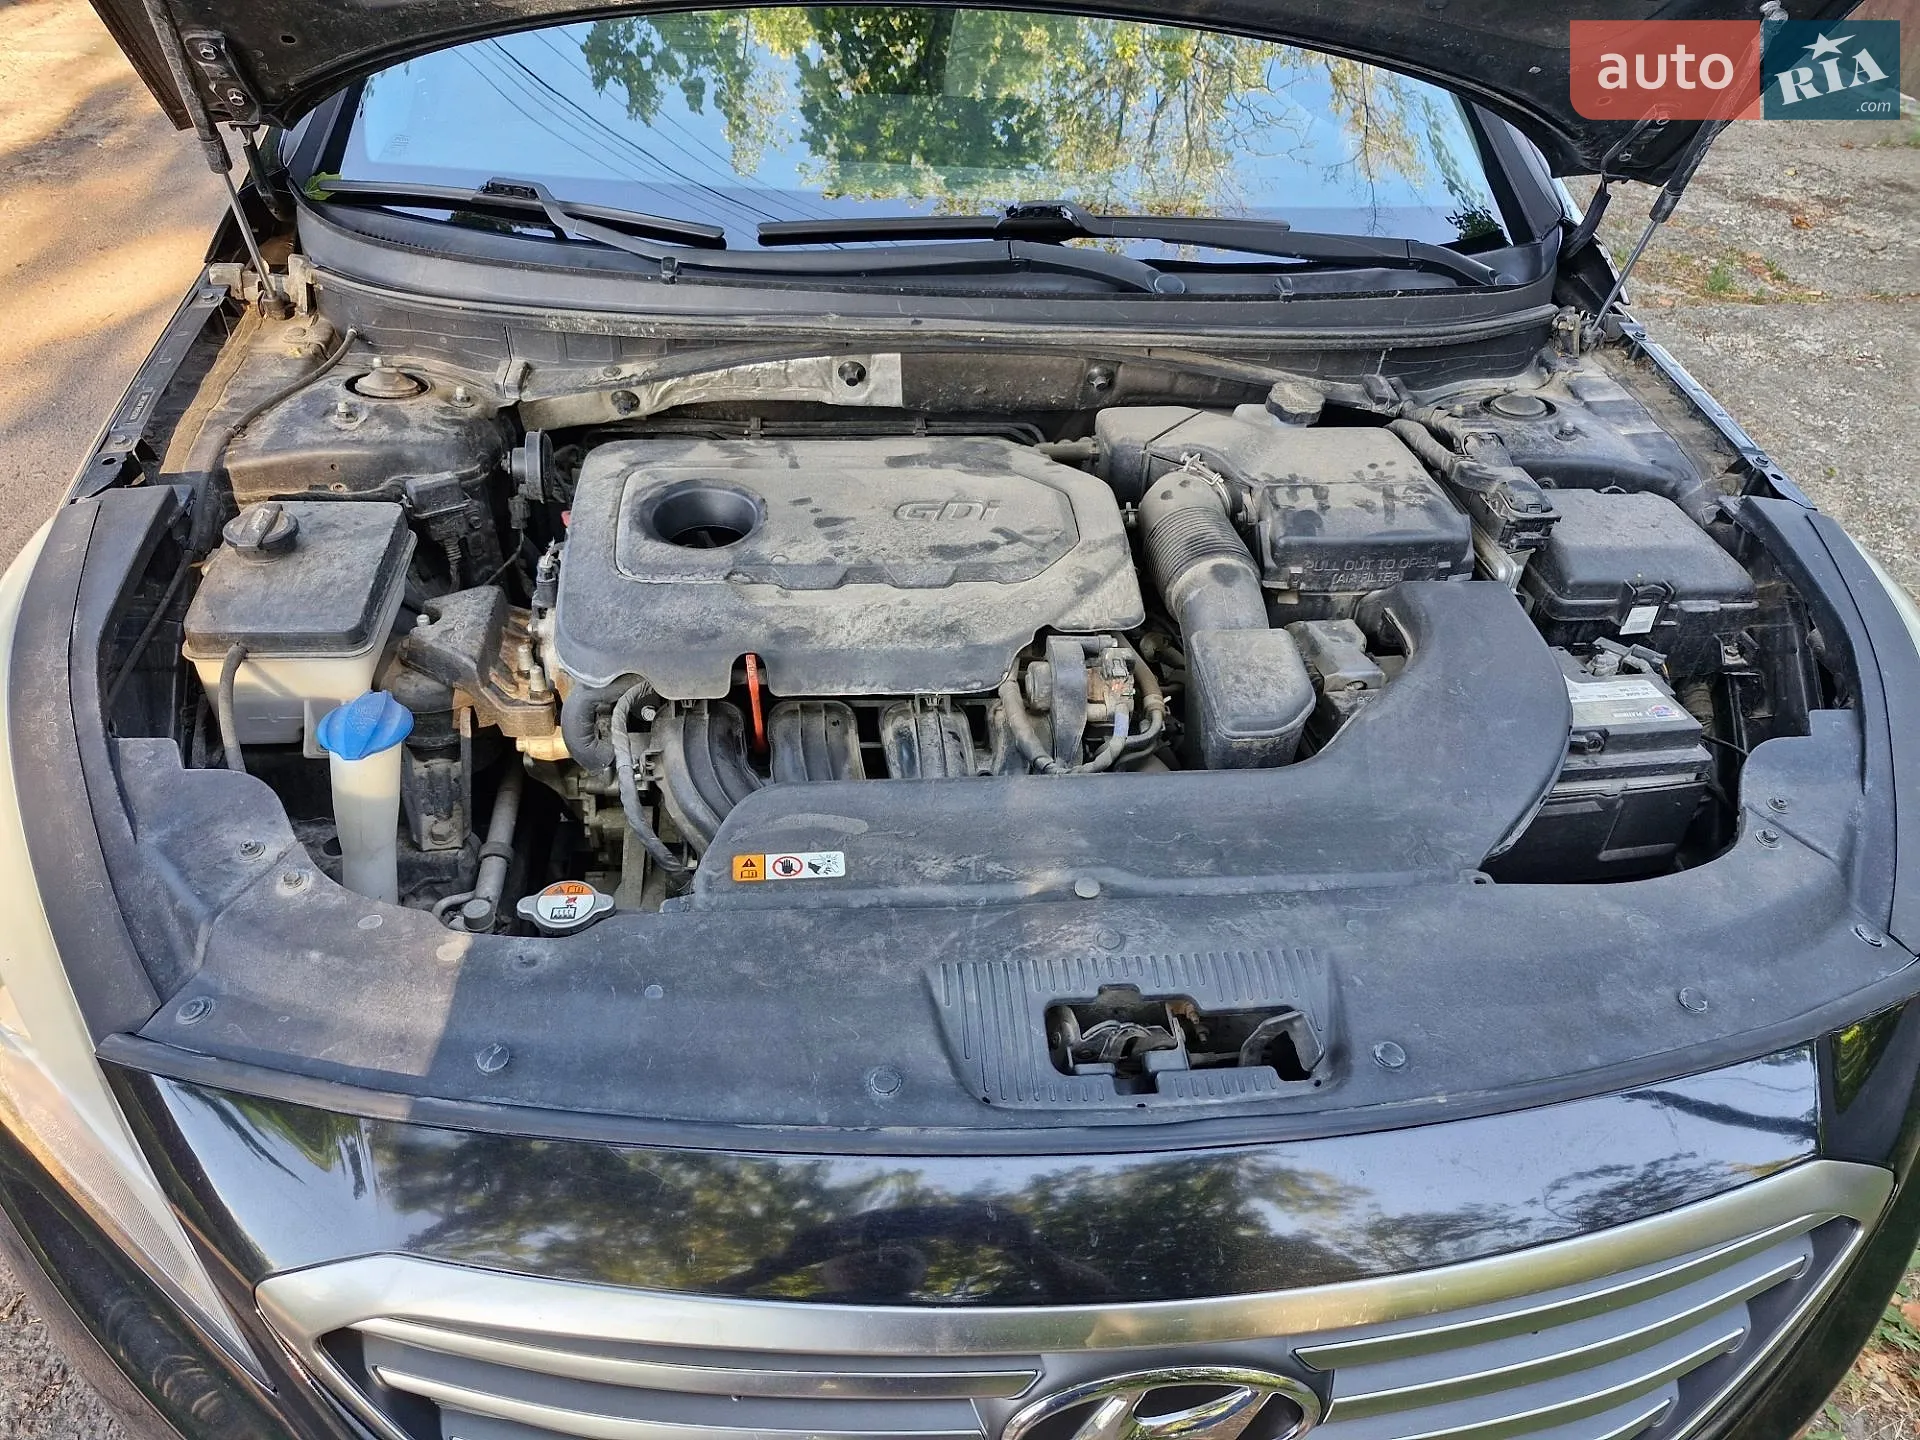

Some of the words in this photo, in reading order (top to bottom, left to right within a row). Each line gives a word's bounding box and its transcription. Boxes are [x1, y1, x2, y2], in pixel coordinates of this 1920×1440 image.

[1304, 559, 1340, 572] PULL
[1343, 558, 1375, 571] OUT
[1378, 558, 1396, 570] TO
[1398, 556, 1439, 569] OPEN
